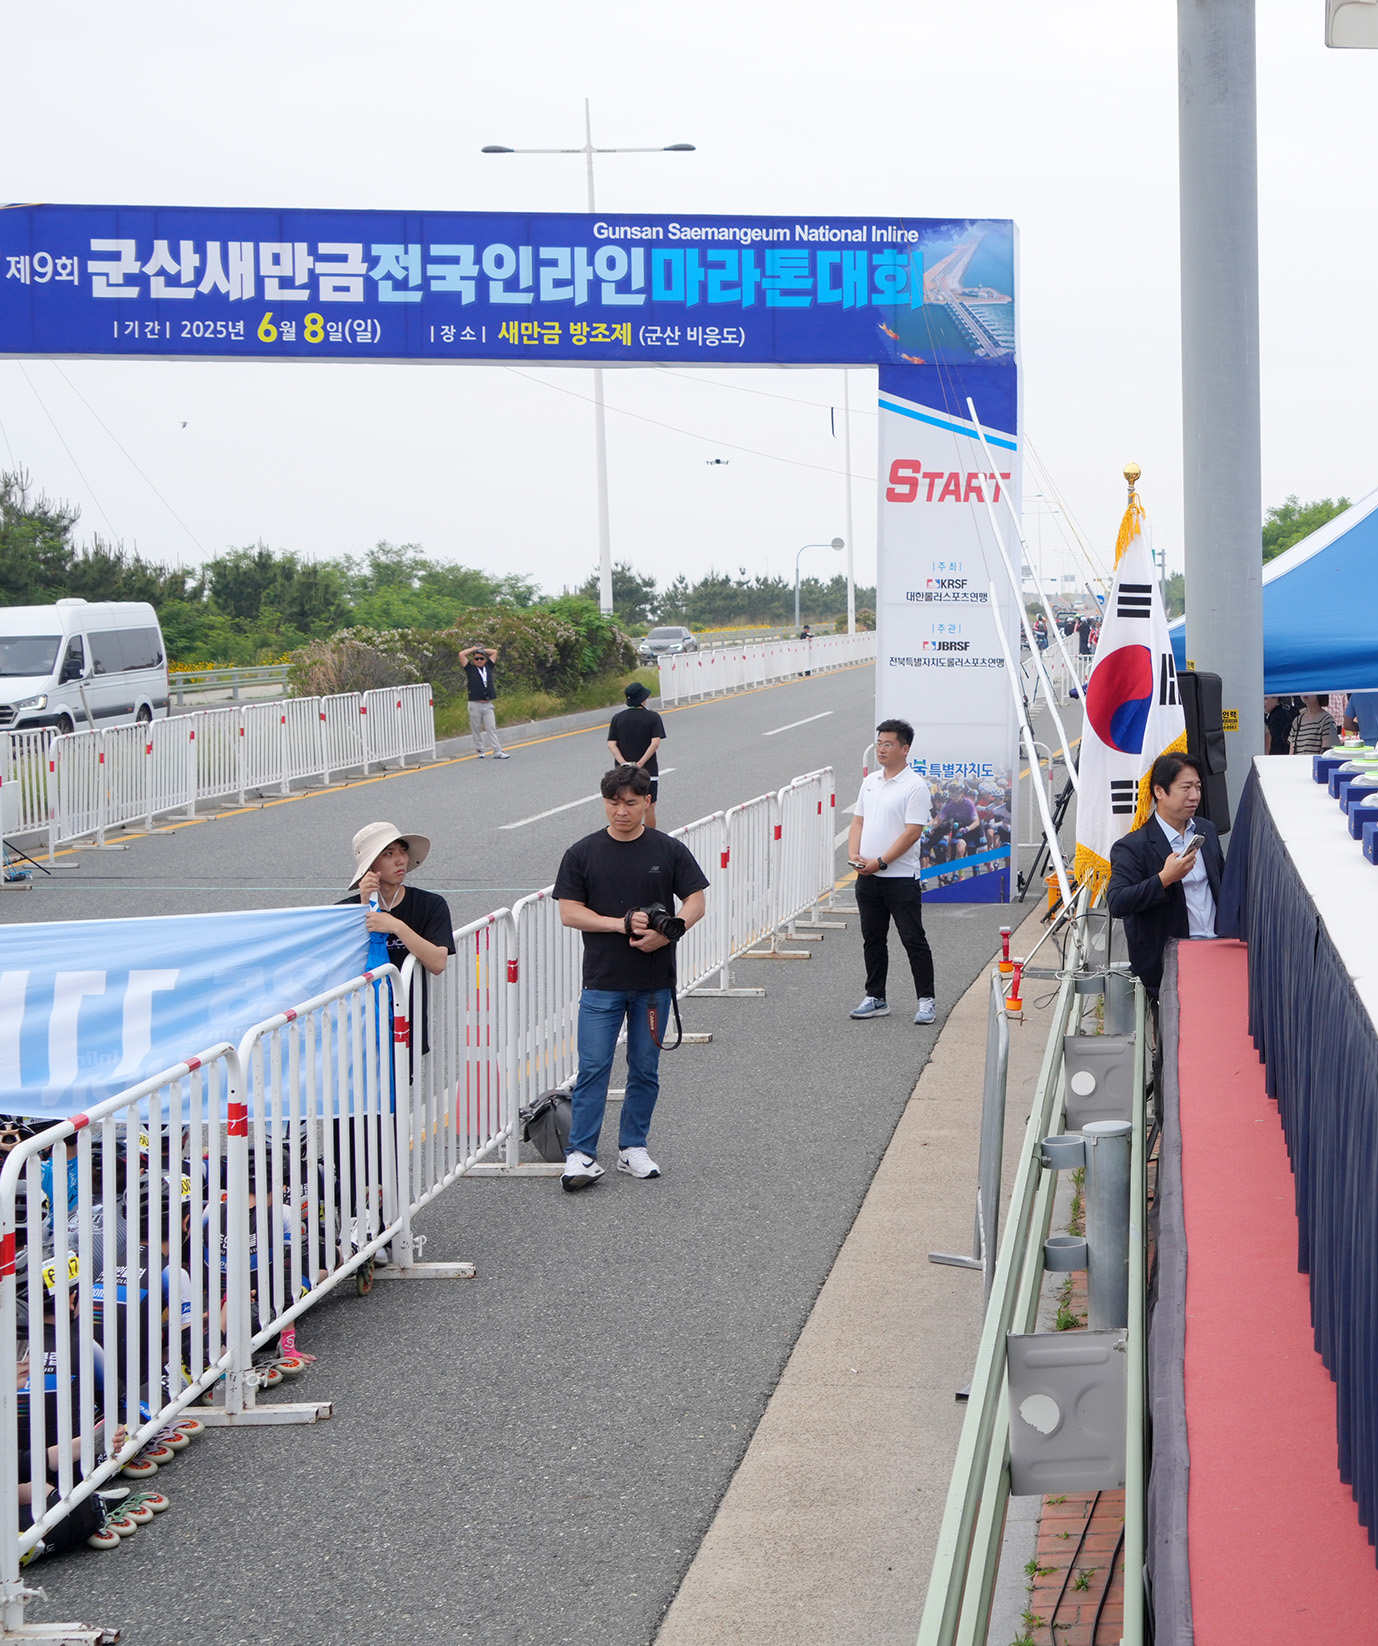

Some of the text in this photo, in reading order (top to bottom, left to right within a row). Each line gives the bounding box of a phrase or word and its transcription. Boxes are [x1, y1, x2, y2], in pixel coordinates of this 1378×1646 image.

[592, 221, 919, 245] Gunsan Saemangeum National Inline
[5, 251, 79, 286] 제9회
[180, 320, 245, 341] 2025년
[257, 311, 297, 343] 6월
[303, 312, 382, 344] 8일(일)
[498, 321, 562, 345] 새만금
[569, 322, 632, 346] 방조제
[638, 326, 682, 346] (군산
[686, 326, 746, 348] 비응도)
[940, 579, 968, 589] KRSF
[937, 641, 970, 651] JBRSF
